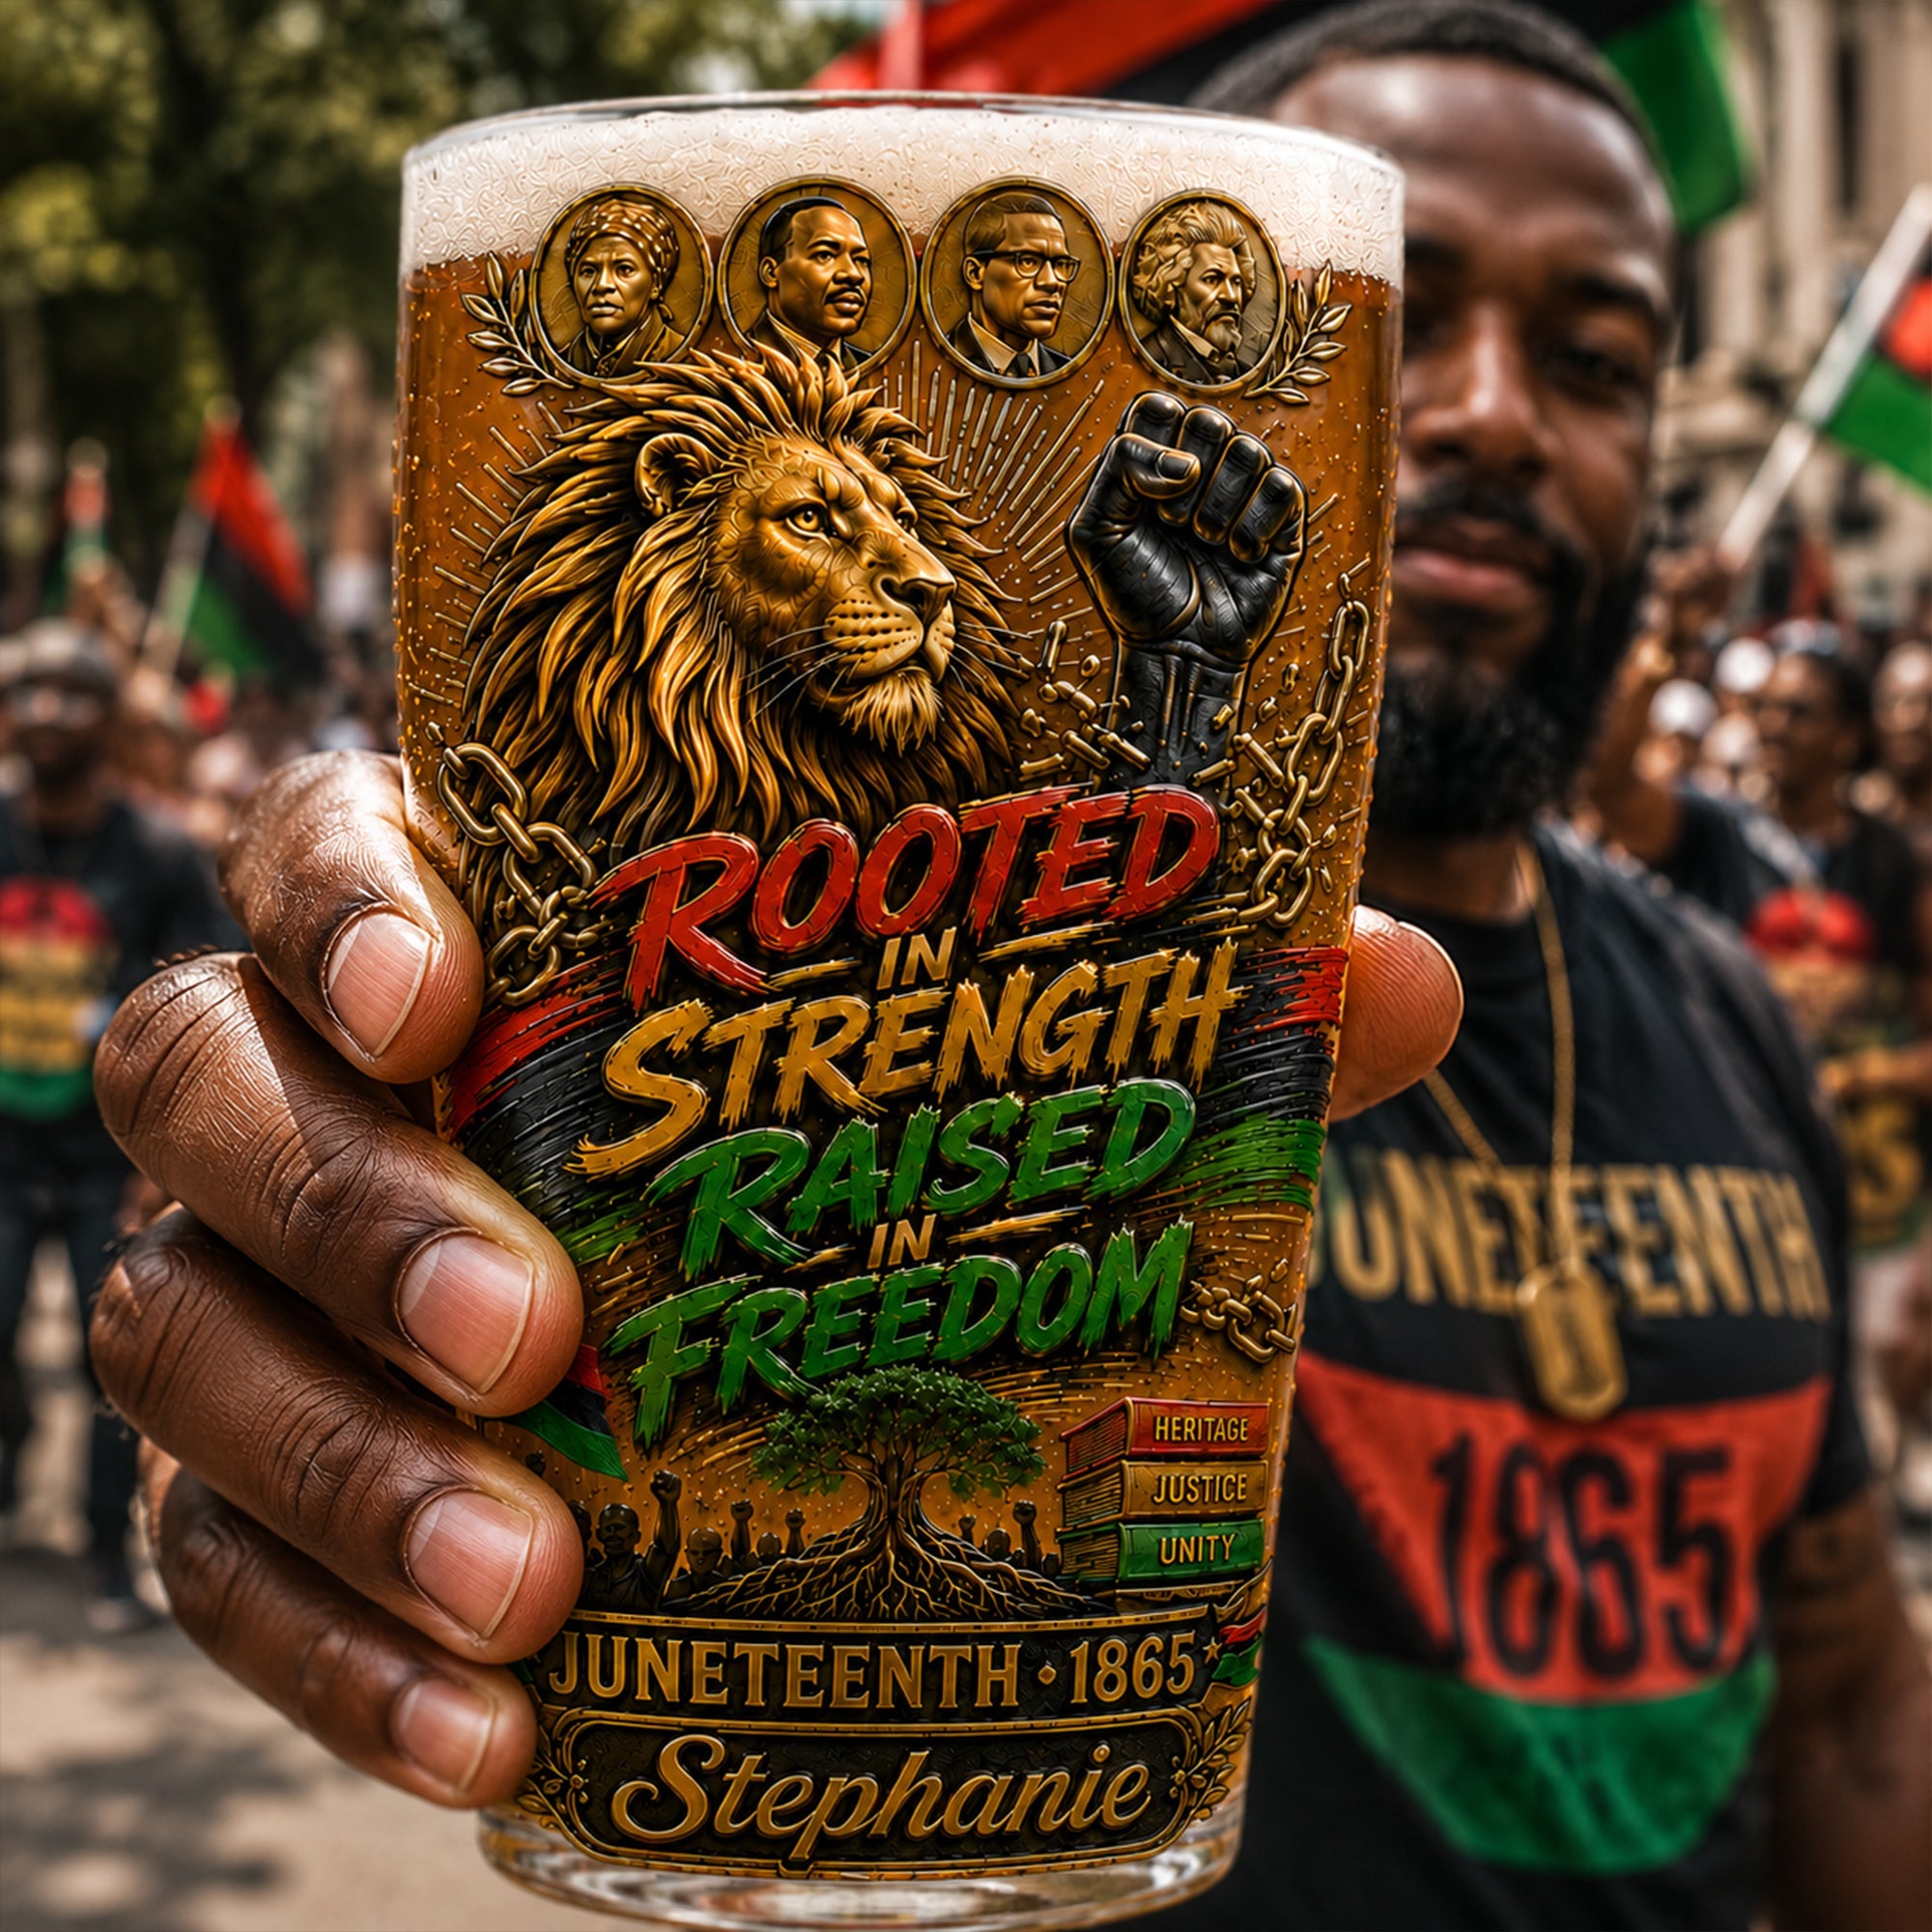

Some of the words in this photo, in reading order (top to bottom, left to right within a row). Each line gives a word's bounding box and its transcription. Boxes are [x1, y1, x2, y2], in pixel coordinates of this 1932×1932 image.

[587, 784, 1221, 1010] ROOTED
[883, 927, 956, 990] IN
[563, 937, 1252, 1176] STRENGTH
[640, 1078, 1196, 1276] RAISED
[867, 1214, 937, 1268] IN
[601, 1215, 1195, 1449] FREEDOM
[1154, 1415, 1250, 1442] HERITAGE
[1153, 1472, 1248, 1503] JUSTICE
[1160, 1533, 1236, 1565] UNITY
[1428, 1430, 1736, 1681] 1865
[549, 1631, 1021, 1708] JUNETEENTH
[1069, 1632, 1196, 1705] 1865
[611, 1734, 1152, 1861] Stephanie
